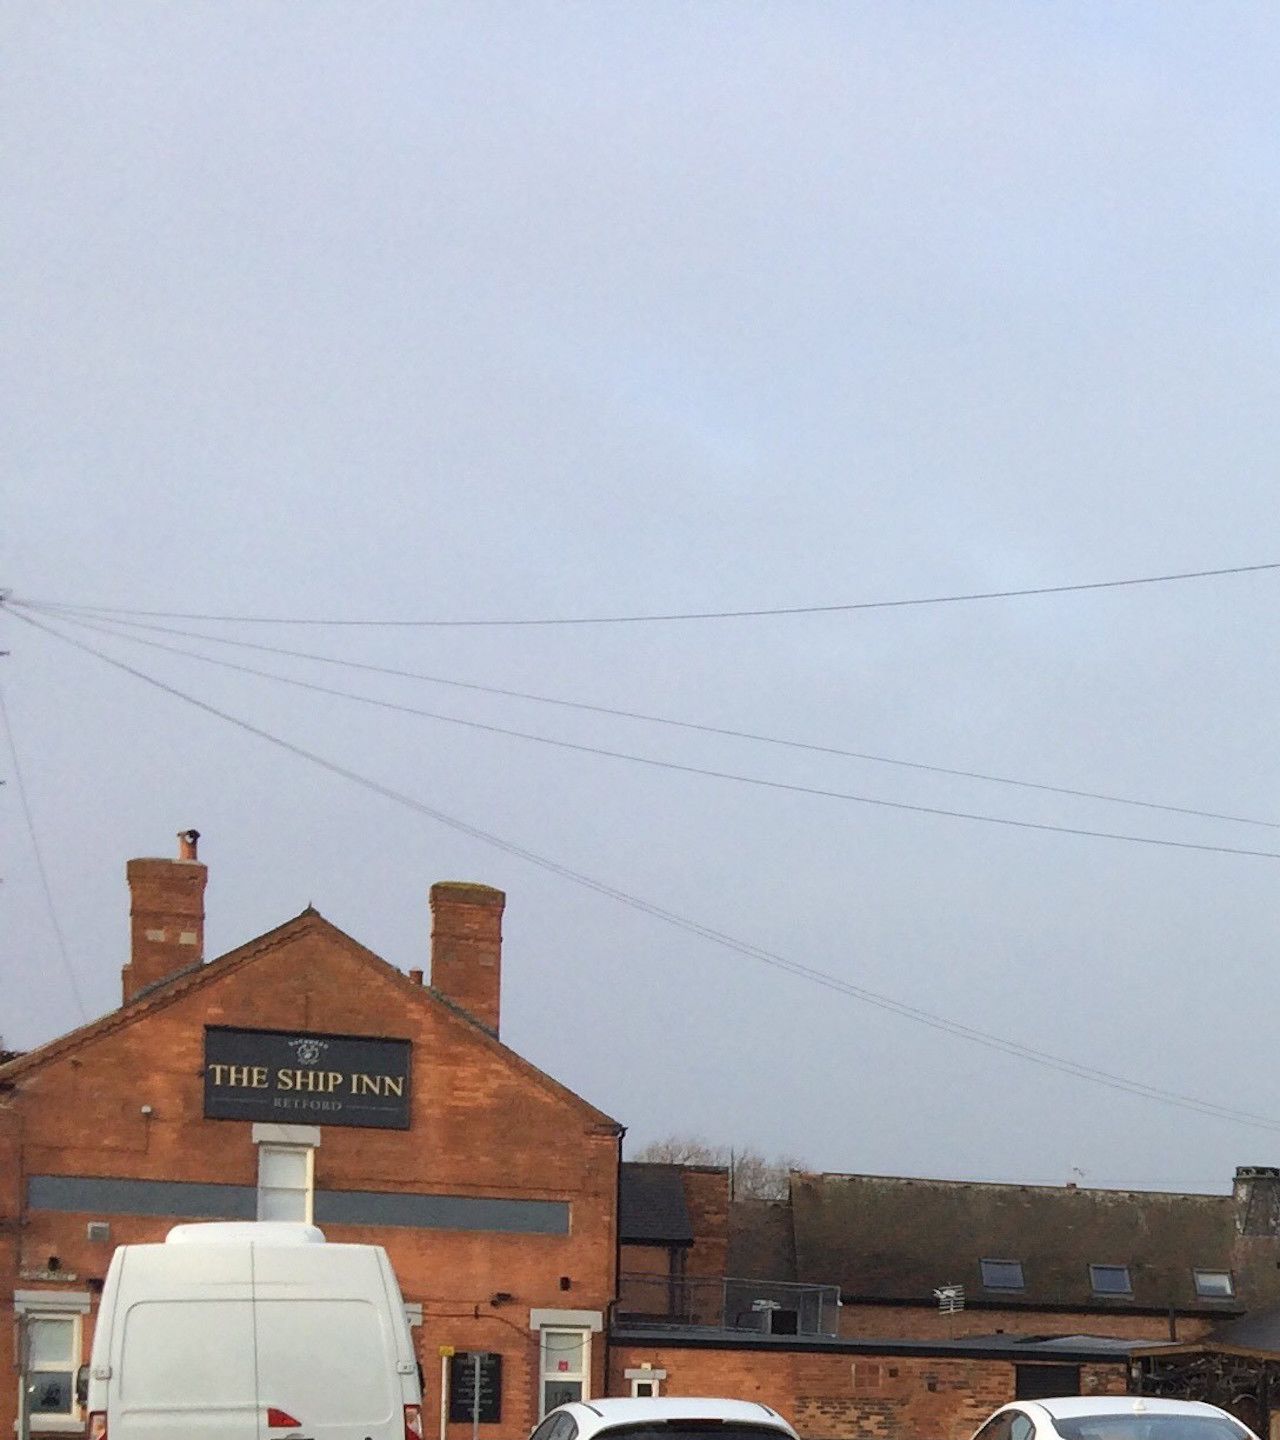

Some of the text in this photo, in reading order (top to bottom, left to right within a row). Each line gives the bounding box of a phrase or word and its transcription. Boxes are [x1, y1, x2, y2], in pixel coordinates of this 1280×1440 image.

[209, 1064, 405, 1097] THE SHIP INN
[273, 1097, 342, 1112] RETFORD
